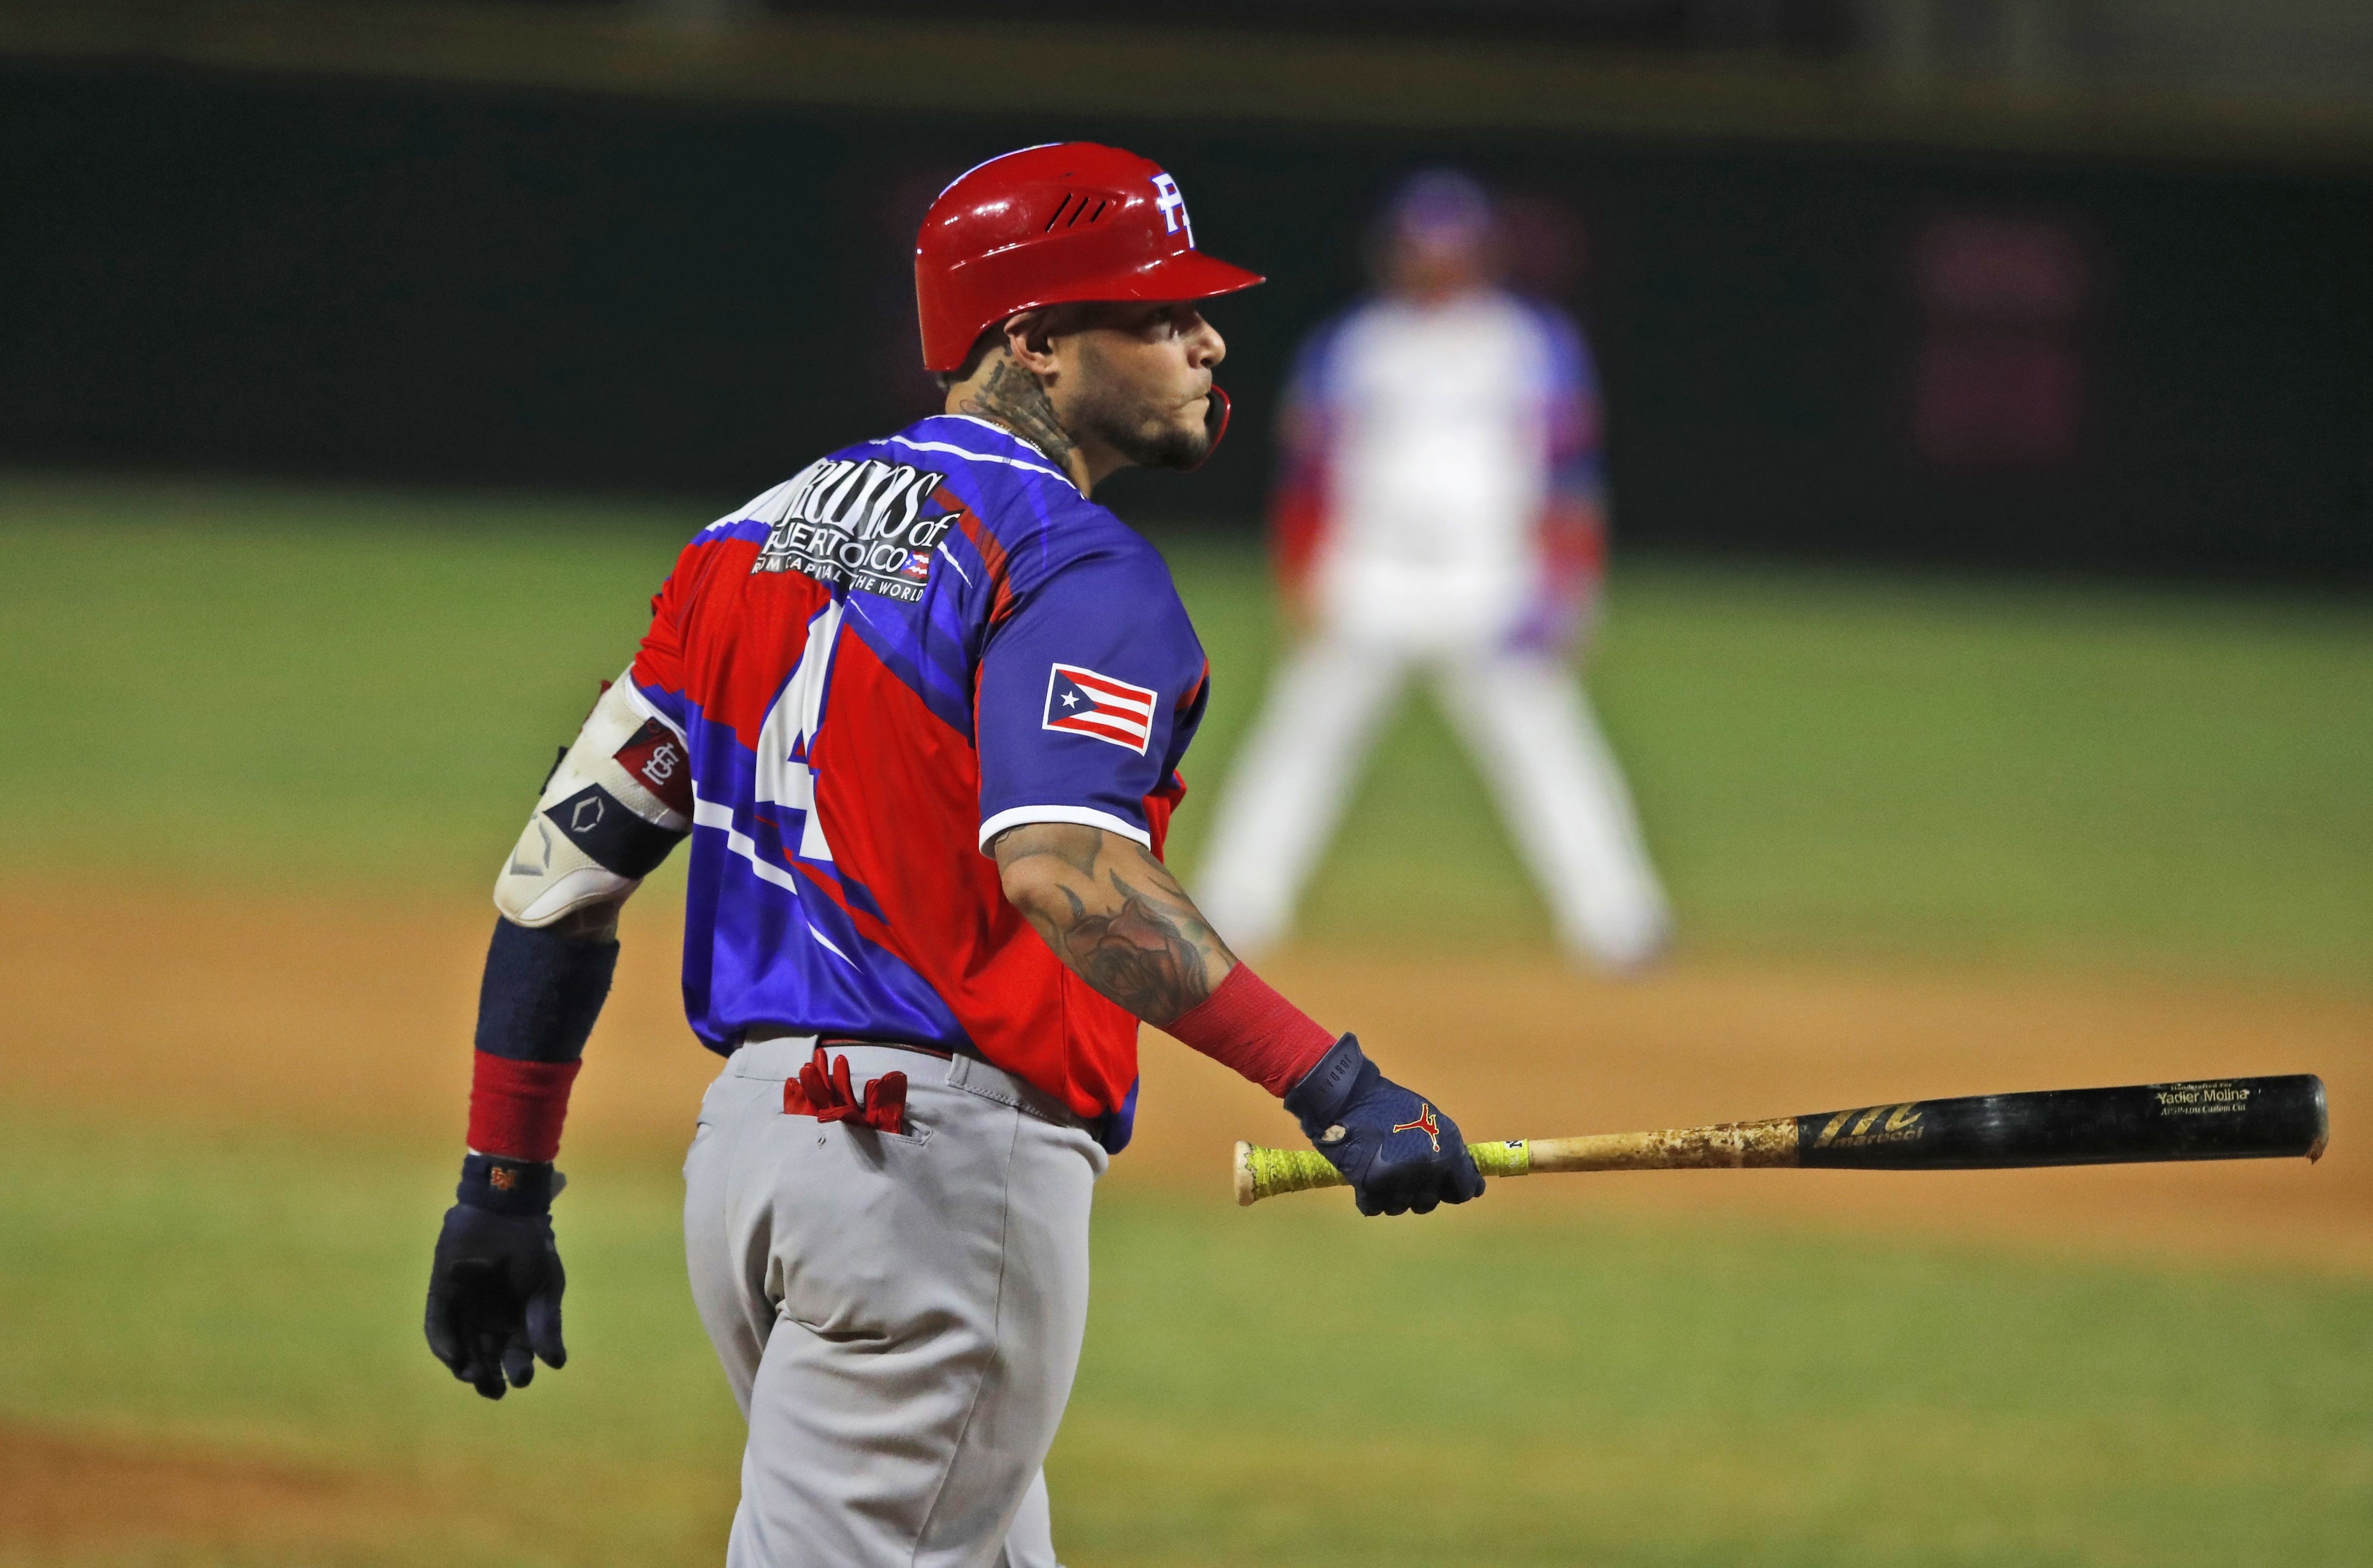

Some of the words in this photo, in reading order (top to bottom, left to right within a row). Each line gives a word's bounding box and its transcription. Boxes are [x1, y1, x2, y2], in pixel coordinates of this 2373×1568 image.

[909, 513, 961, 547] of
[862, 541, 909, 572] ICO
[878, 581, 924, 602] WORLD
[754, 598, 845, 862] 4
[2157, 1090, 2200, 1105] Yadier
[2204, 1088, 2249, 1102] Molina
